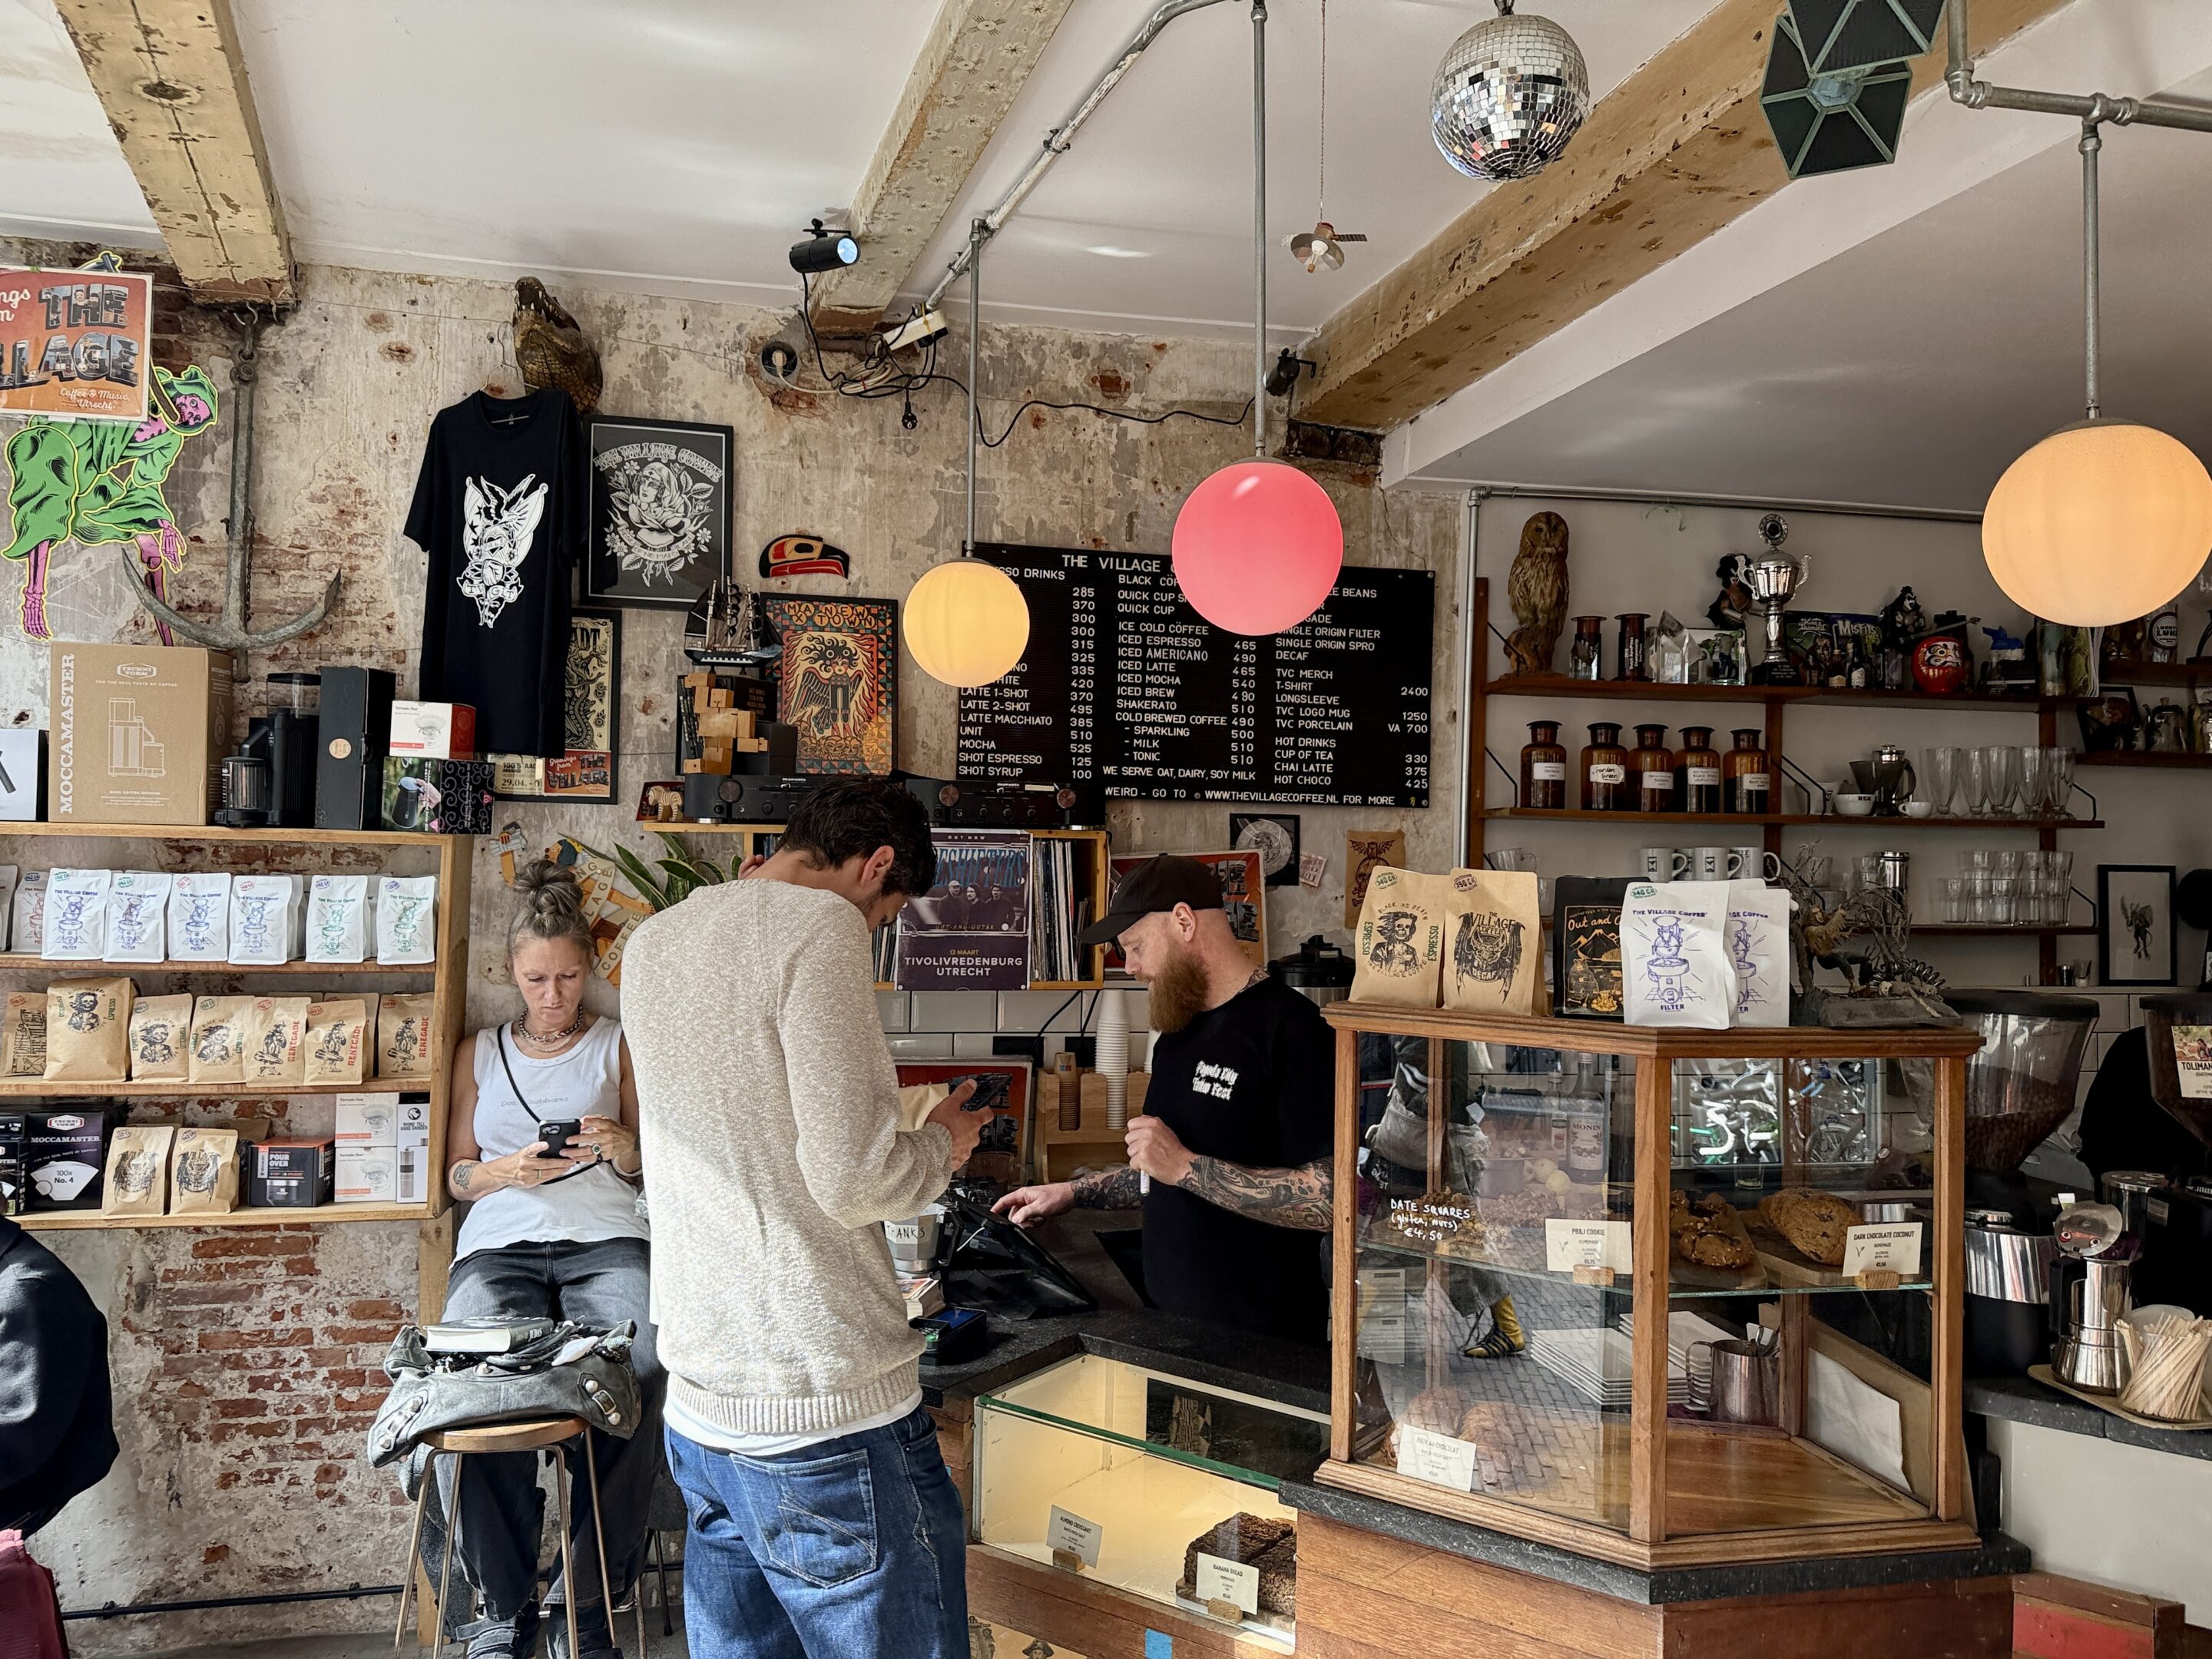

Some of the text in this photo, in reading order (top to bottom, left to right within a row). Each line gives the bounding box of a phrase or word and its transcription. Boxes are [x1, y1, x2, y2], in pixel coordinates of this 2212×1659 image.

[39, 283, 129, 329] THE
[60, 388, 86, 400] Coffee
[1062, 555, 1161, 572] THE VILLAGE
[1024, 568, 1065, 580] DRINKS
[1118, 575, 1151, 585] BLACK
[1154, 592, 1175, 601] CUP
[1343, 588, 1377, 598] BEANS
[1154, 605, 1174, 614] CUP
[1119, 621, 1209, 634] ICE COLD CÖFFEE
[1315, 628, 1346, 637] ORIGIN
[1349, 629, 1380, 638] FILTER
[1118, 635, 1201, 647] ICED ESPRESSO
[1276, 638, 1375, 651] SINGLE ORIGIN SPRO
[1118, 647, 1208, 661] ICED AMERICANO
[1276, 651, 1309, 661] DECAF
[1118, 661, 1176, 671] ICED LATTE
[1118, 674, 1181, 685] ICED MOCHA
[1277, 669, 1333, 679] TVC MERCH
[1071, 679, 1094, 688] 420
[1277, 681, 1428, 697] T-SHIRT 2400
[961, 687, 1093, 701] LATTE 1-SHOT 370
[1118, 687, 1175, 697] ICED BREW
[1117, 700, 1177, 710] SHAKERATO
[1276, 694, 1339, 705] LONGSLEEVE
[961, 700, 1093, 714] LATTE 2-SHOT 495
[1116, 713, 1227, 725] COLD BREWED COFFEE
[1276, 707, 1427, 720] TVC LOGO MUG 1250
[961, 714, 1093, 727] LATTE MACCHIATO 385
[1276, 719, 1428, 733] TVC PORCELAIN VA 700
[60, 654, 75, 813] MOCCAMASTER
[960, 727, 983, 735] UNIT
[1134, 726, 1190, 737] SPARKLING
[960, 740, 1091, 753] MOCHA 525
[1134, 739, 1160, 748] MILK
[1275, 737, 1336, 748] HOT DRINKS
[959, 753, 1042, 764] SHOT ESPRESSO
[1133, 752, 1160, 761] TONIC
[1275, 750, 1427, 763] CUP OF TEA 330
[959, 766, 1023, 777] SHOT SYRUP
[1103, 766, 1256, 780] WE SERVE OAT, DAIRY, SOY MILK
[1274, 762, 1427, 776] CHAI LATTE 375
[1274, 775, 1428, 788] HOT CHOCO 425
[1105, 787, 1138, 796] WEIRD
[1152, 789, 1167, 797] GO
[1174, 790, 1186, 798] TO
[1343, 796, 1362, 804] FOR
[1369, 796, 1395, 805] MORE
[1470, 912, 1516, 932] VILLAGE
[1568, 916, 1611, 930] Out and
[1362, 922, 1373, 955] ESPRESSO
[1428, 926, 1439, 962] ESPRESSO
[905, 957, 1022, 965] TIVOLIVREDENBURG
[937, 968, 991, 976] UTRECHT
[1472, 969, 1496, 980] DECAF
[288, 1020, 300, 1062] RENEGADE
[419, 1016, 429, 1057] RENEGADE
[348, 1025, 362, 1066] RENEGADE
[1390, 1198, 1471, 1219] DATE SQUARES
[887, 1226, 925, 1239] THANKS
[1403, 1229, 1442, 1241] €4,50
[1214, 1564, 1243, 1577] BANANA BREAD
